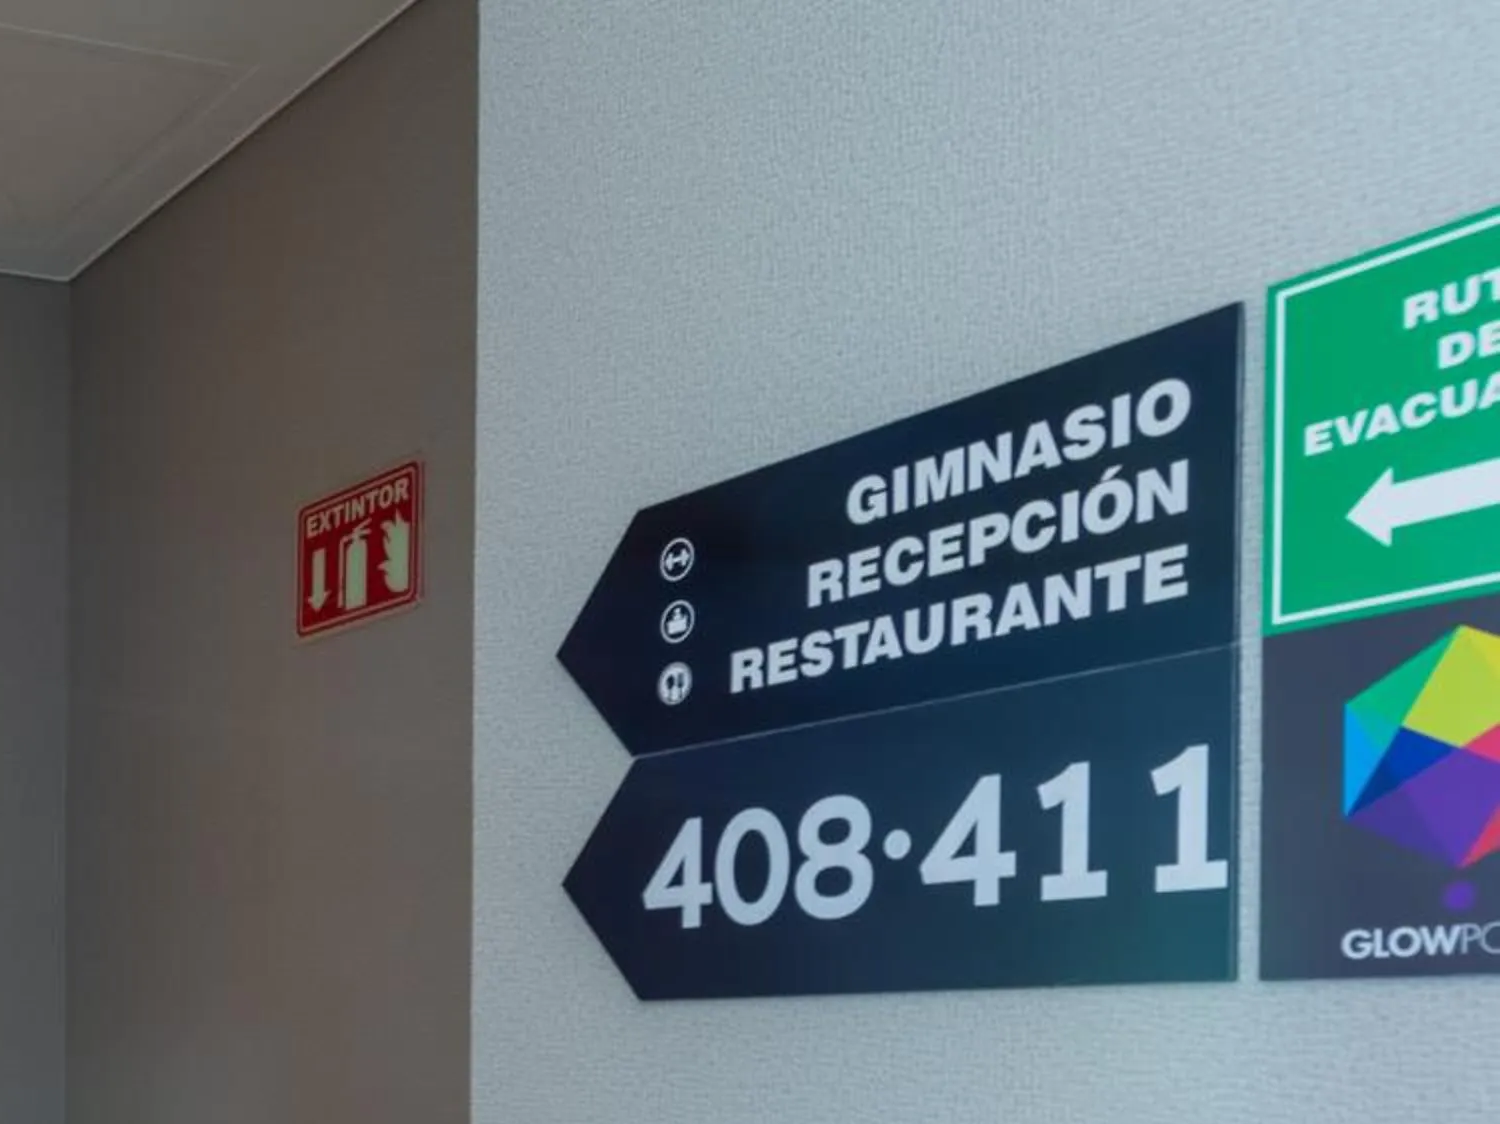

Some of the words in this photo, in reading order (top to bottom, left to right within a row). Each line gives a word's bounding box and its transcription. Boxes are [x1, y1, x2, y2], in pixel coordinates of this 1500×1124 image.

[1437, 321, 1500, 369] DE
[306, 478, 409, 539] EXTINTOR
[846, 378, 1191, 525] GIMNASIO
[807, 459, 1189, 608] RECEPCIÓN
[730, 543, 1189, 694] RESTAURANTE
